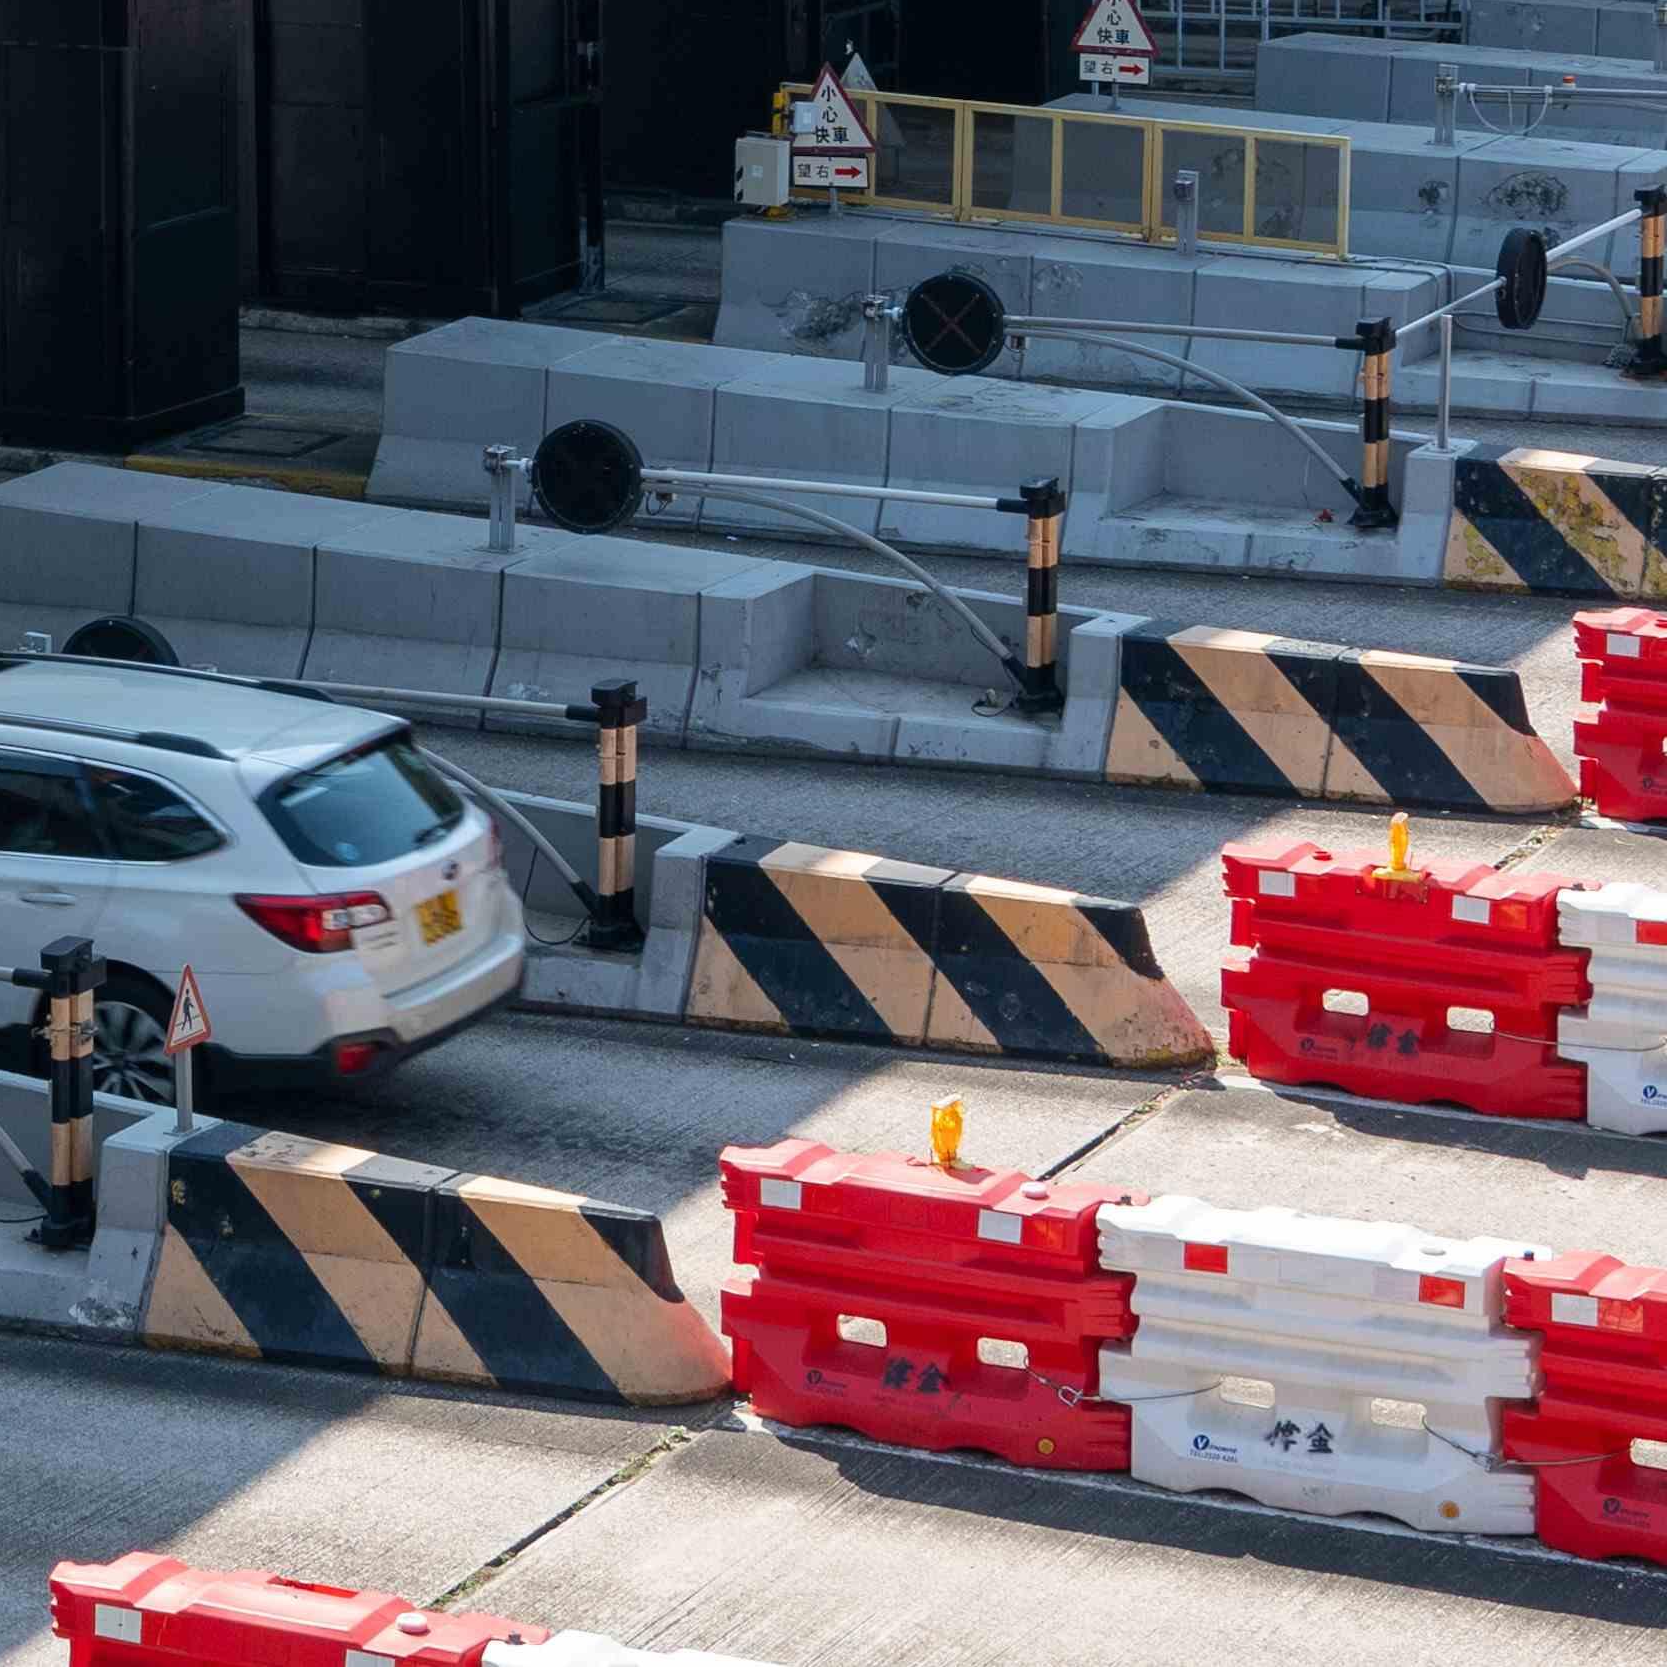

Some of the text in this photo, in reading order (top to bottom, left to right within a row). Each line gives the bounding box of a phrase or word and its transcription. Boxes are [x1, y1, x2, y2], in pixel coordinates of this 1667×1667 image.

[1097, 28, 1130, 45] 快車
[1083, 60, 1113, 75] 望右
[813, 125, 849, 144] 快車
[797, 163, 829, 179] 望右
